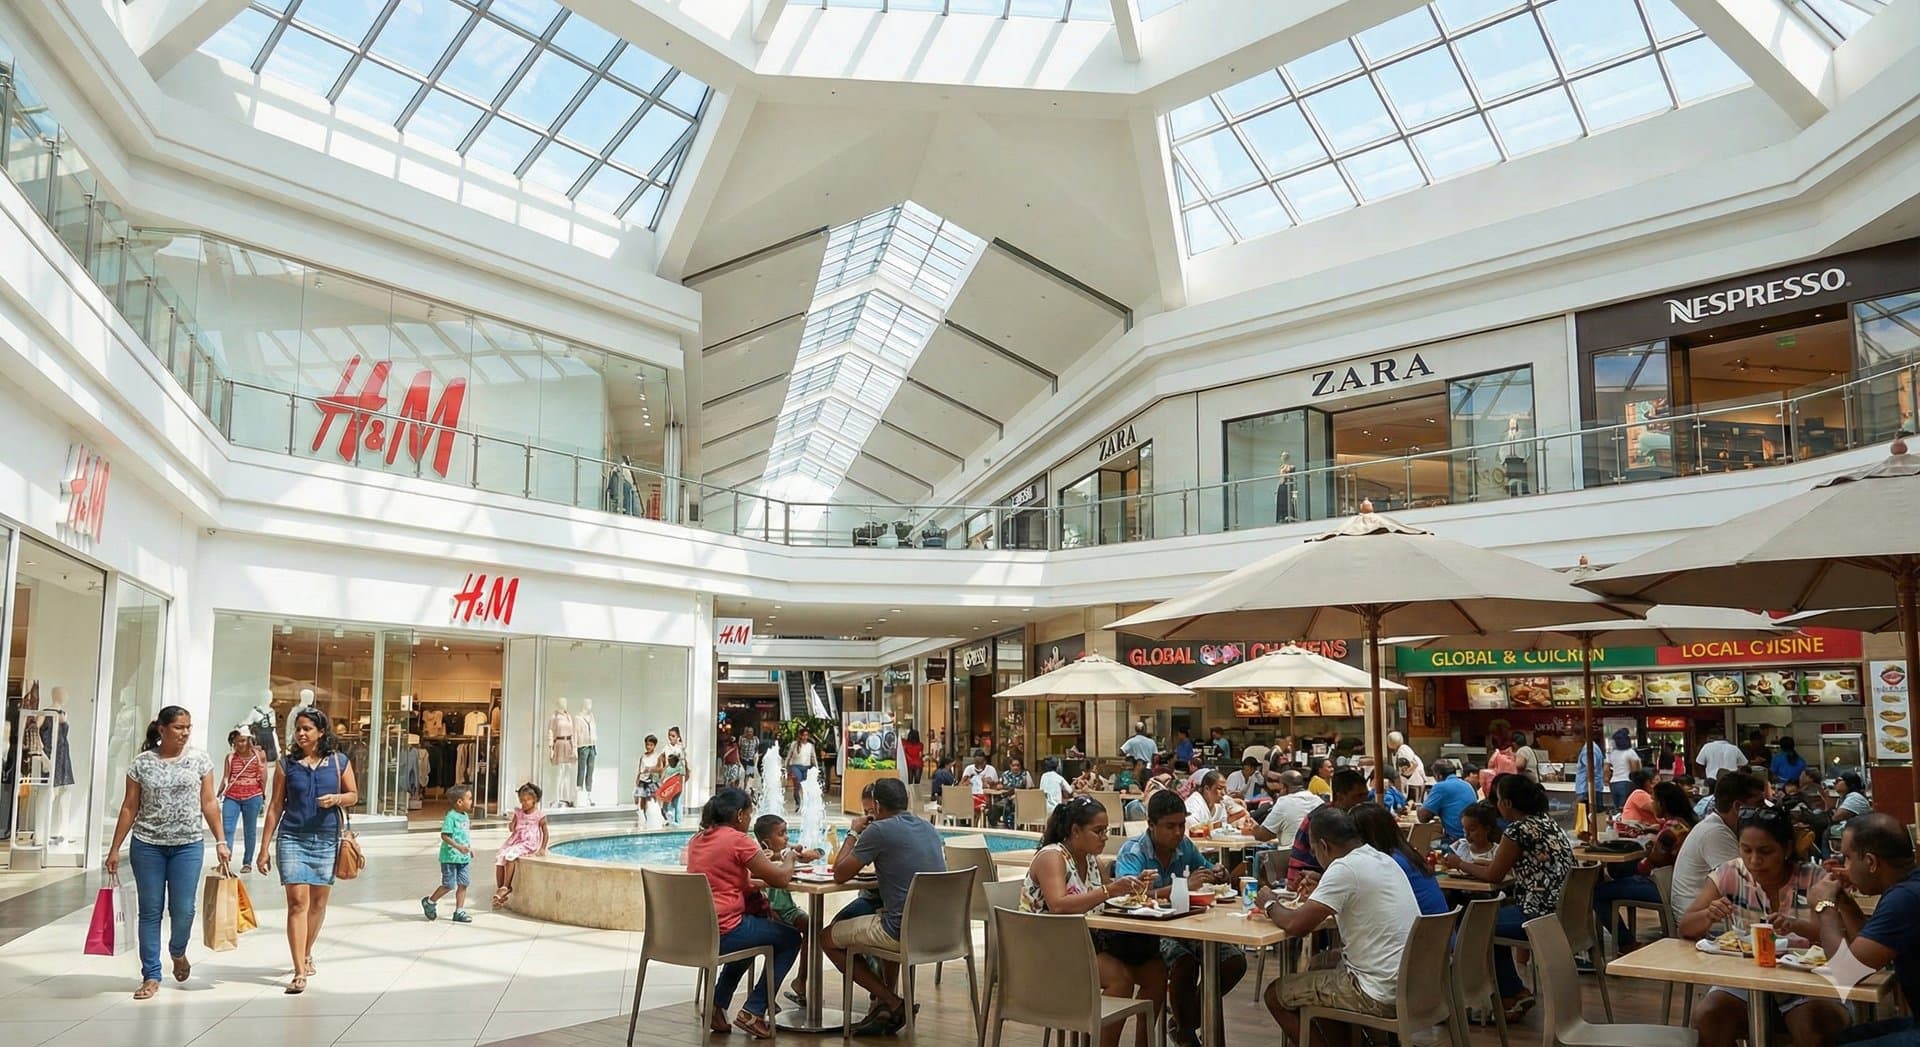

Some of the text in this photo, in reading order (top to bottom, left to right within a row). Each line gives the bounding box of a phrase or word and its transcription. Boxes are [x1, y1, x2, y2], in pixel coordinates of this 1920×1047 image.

[1664, 268, 1846, 323] NESPRESSO
[1312, 353, 1434, 396] ZARA
[311, 353, 467, 479] H&M
[1099, 424, 1137, 461] ZARA
[453, 573, 520, 625] H&M
[1129, 647, 1197, 666] GLOBAL
[1250, 640, 1347, 659] CHENS
[1432, 651, 1496, 667] GLOBAL
[1503, 650, 1516, 664] &
[1682, 641, 1744, 658] LOCAL
